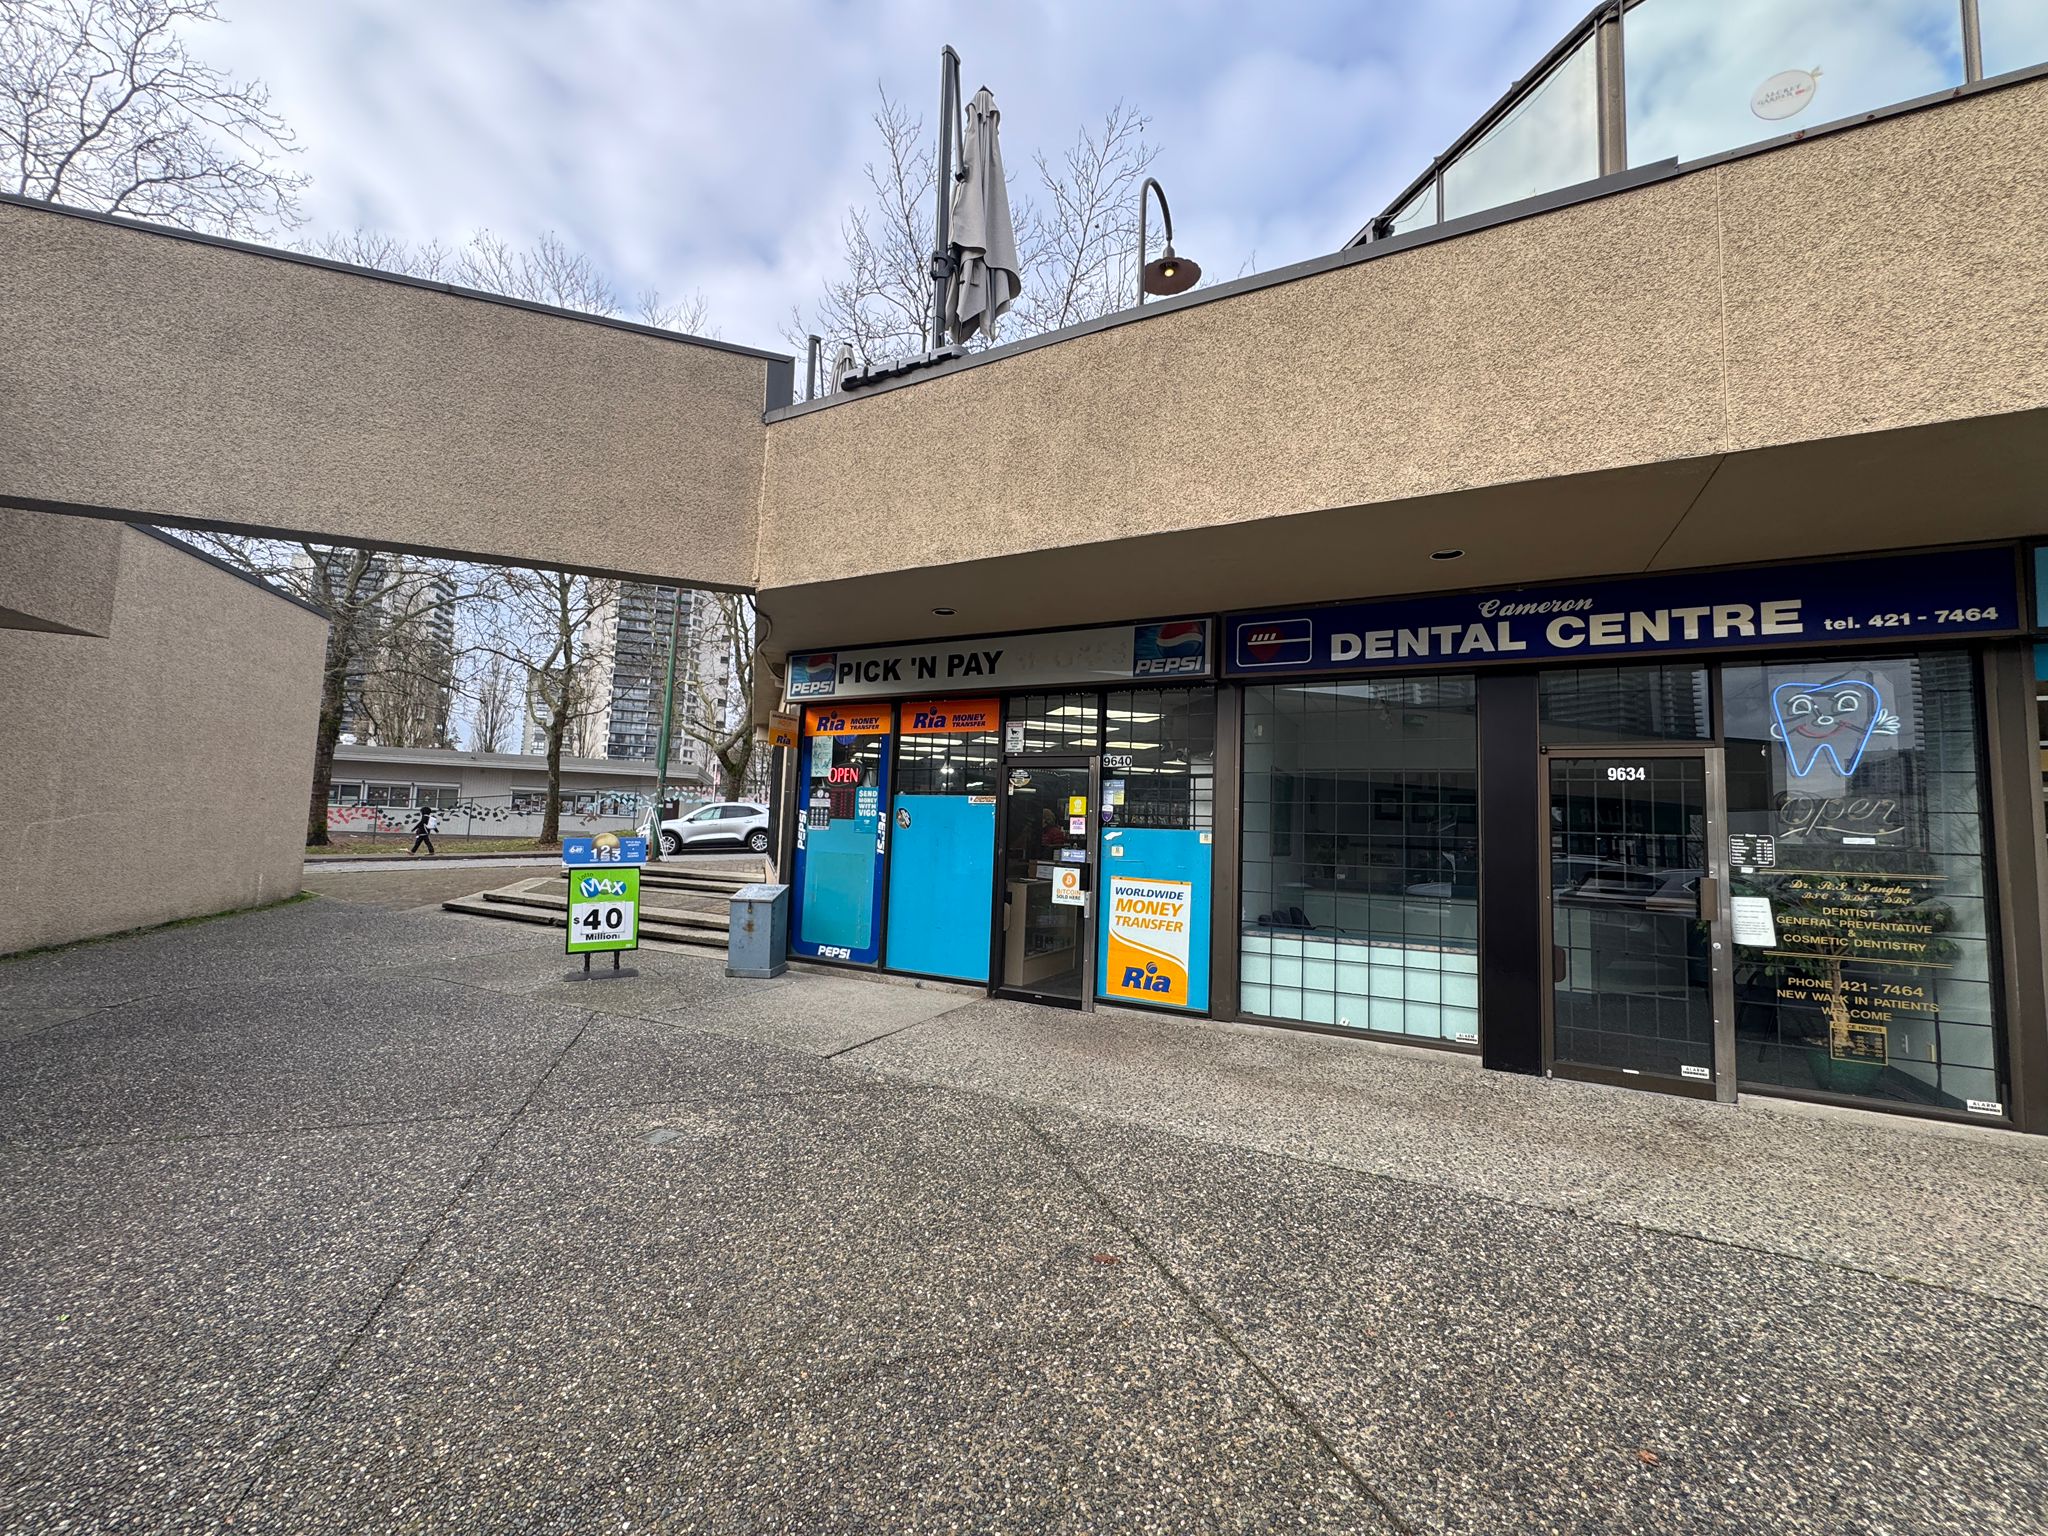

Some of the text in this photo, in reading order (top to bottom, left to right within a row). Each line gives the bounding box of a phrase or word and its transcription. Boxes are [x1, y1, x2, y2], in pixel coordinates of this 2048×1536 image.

[1478, 597, 1594, 618] Cameron
[1330, 621, 1527, 662] DENTAL
[1545, 600, 1804, 648] CENTRE
[1824, 616, 1861, 631] tel.
[1868, 612, 1911, 628] 421
[1934, 606, 1999, 624] 7464
[838, 658, 902, 684] PICK
[947, 650, 1003, 678] PAY
[1134, 656, 1203, 674] PEPSI
[791, 680, 834, 695] PEPSI
[816, 710, 845, 732] Ria
[850, 717, 880, 725] MONEY
[913, 706, 947, 729] Ria
[952, 713, 986, 722] MONEY
[952, 720, 986, 728] TRANSFER
[776, 733, 792, 745] Ria
[1103, 756, 1132, 767] 9640
[827, 767, 859, 783] OPEN
[1607, 767, 1646, 781] 9634
[858, 808, 877, 817] VIGO
[797, 809, 807, 851] PEPSI
[876, 812, 886, 855] PEPSI
[580, 878, 625, 898] MAX
[1056, 888, 1082, 896] BITCOIN
[1115, 886, 1185, 900] WORLDWIDE
[1790, 879, 1812, 890] Dr.
[1114, 898, 1184, 918] MONEY
[1822, 907, 1876, 918] DENTIST
[573, 907, 623, 930] $ 40
[1114, 915, 1184, 933] TRANSFER
[1776, 916, 1835, 928] GENERAL
[1839, 919, 1933, 934] PREVENTATIVE
[585, 932, 618, 941] Million
[1847, 929, 1856, 937] &
[1783, 933, 1927, 952] COSMETIC DENTISTRY
[817, 944, 851, 960] PEPSI
[1121, 961, 1172, 993] Ria
[1787, 977, 1833, 990] PHONE
[1839, 981, 1868, 993] 421
[1881, 983, 1924, 998] 7464
[1776, 989, 1940, 1013] NEW WALK IN PATIENTS
